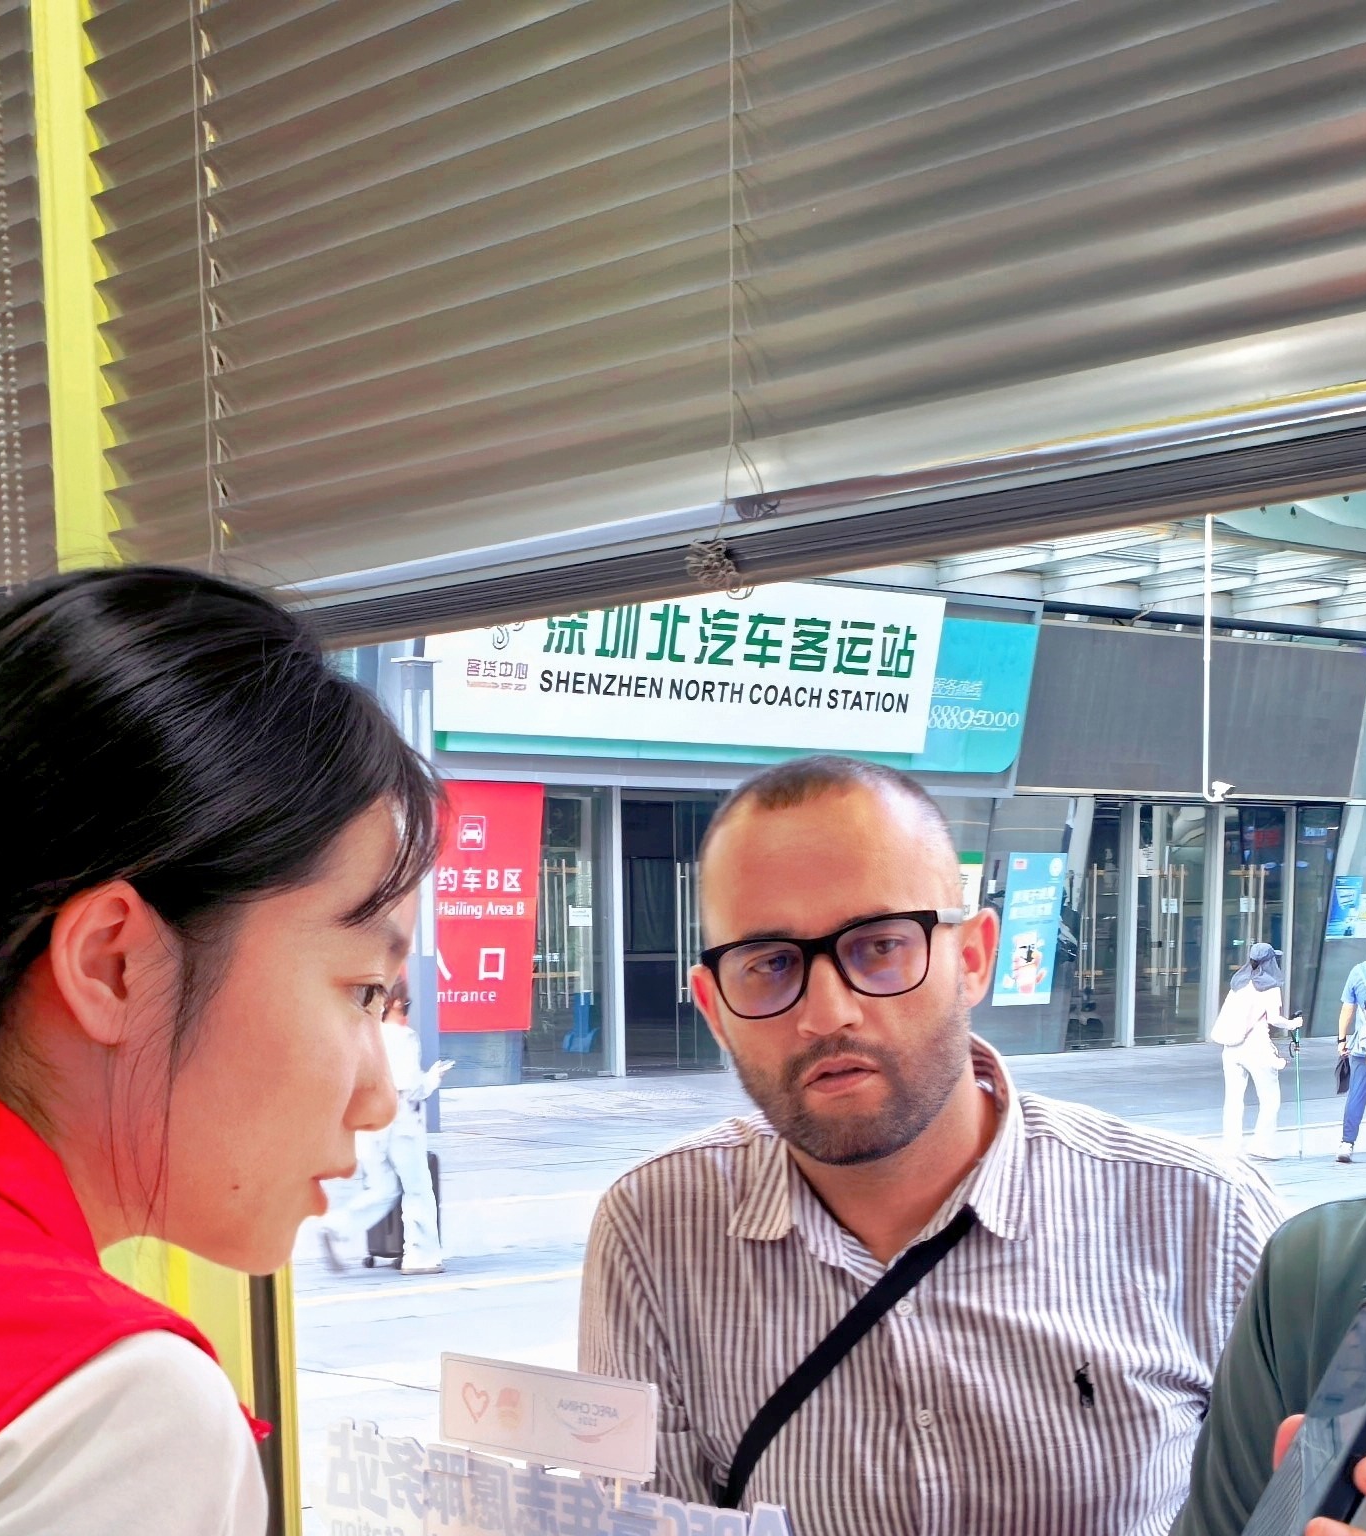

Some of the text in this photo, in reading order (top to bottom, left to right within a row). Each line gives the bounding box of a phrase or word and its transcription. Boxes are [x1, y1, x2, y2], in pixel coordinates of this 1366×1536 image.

[543, 602, 917, 678] 深圳北汽车客运站
[539, 669, 909, 714] SHENZHEN NORTH COACH STATION
[437, 867, 523, 893] 约车B区
[486, 900, 514, 916] Area
[516, 900, 525, 916] B
[437, 988, 497, 1003] ntrance
